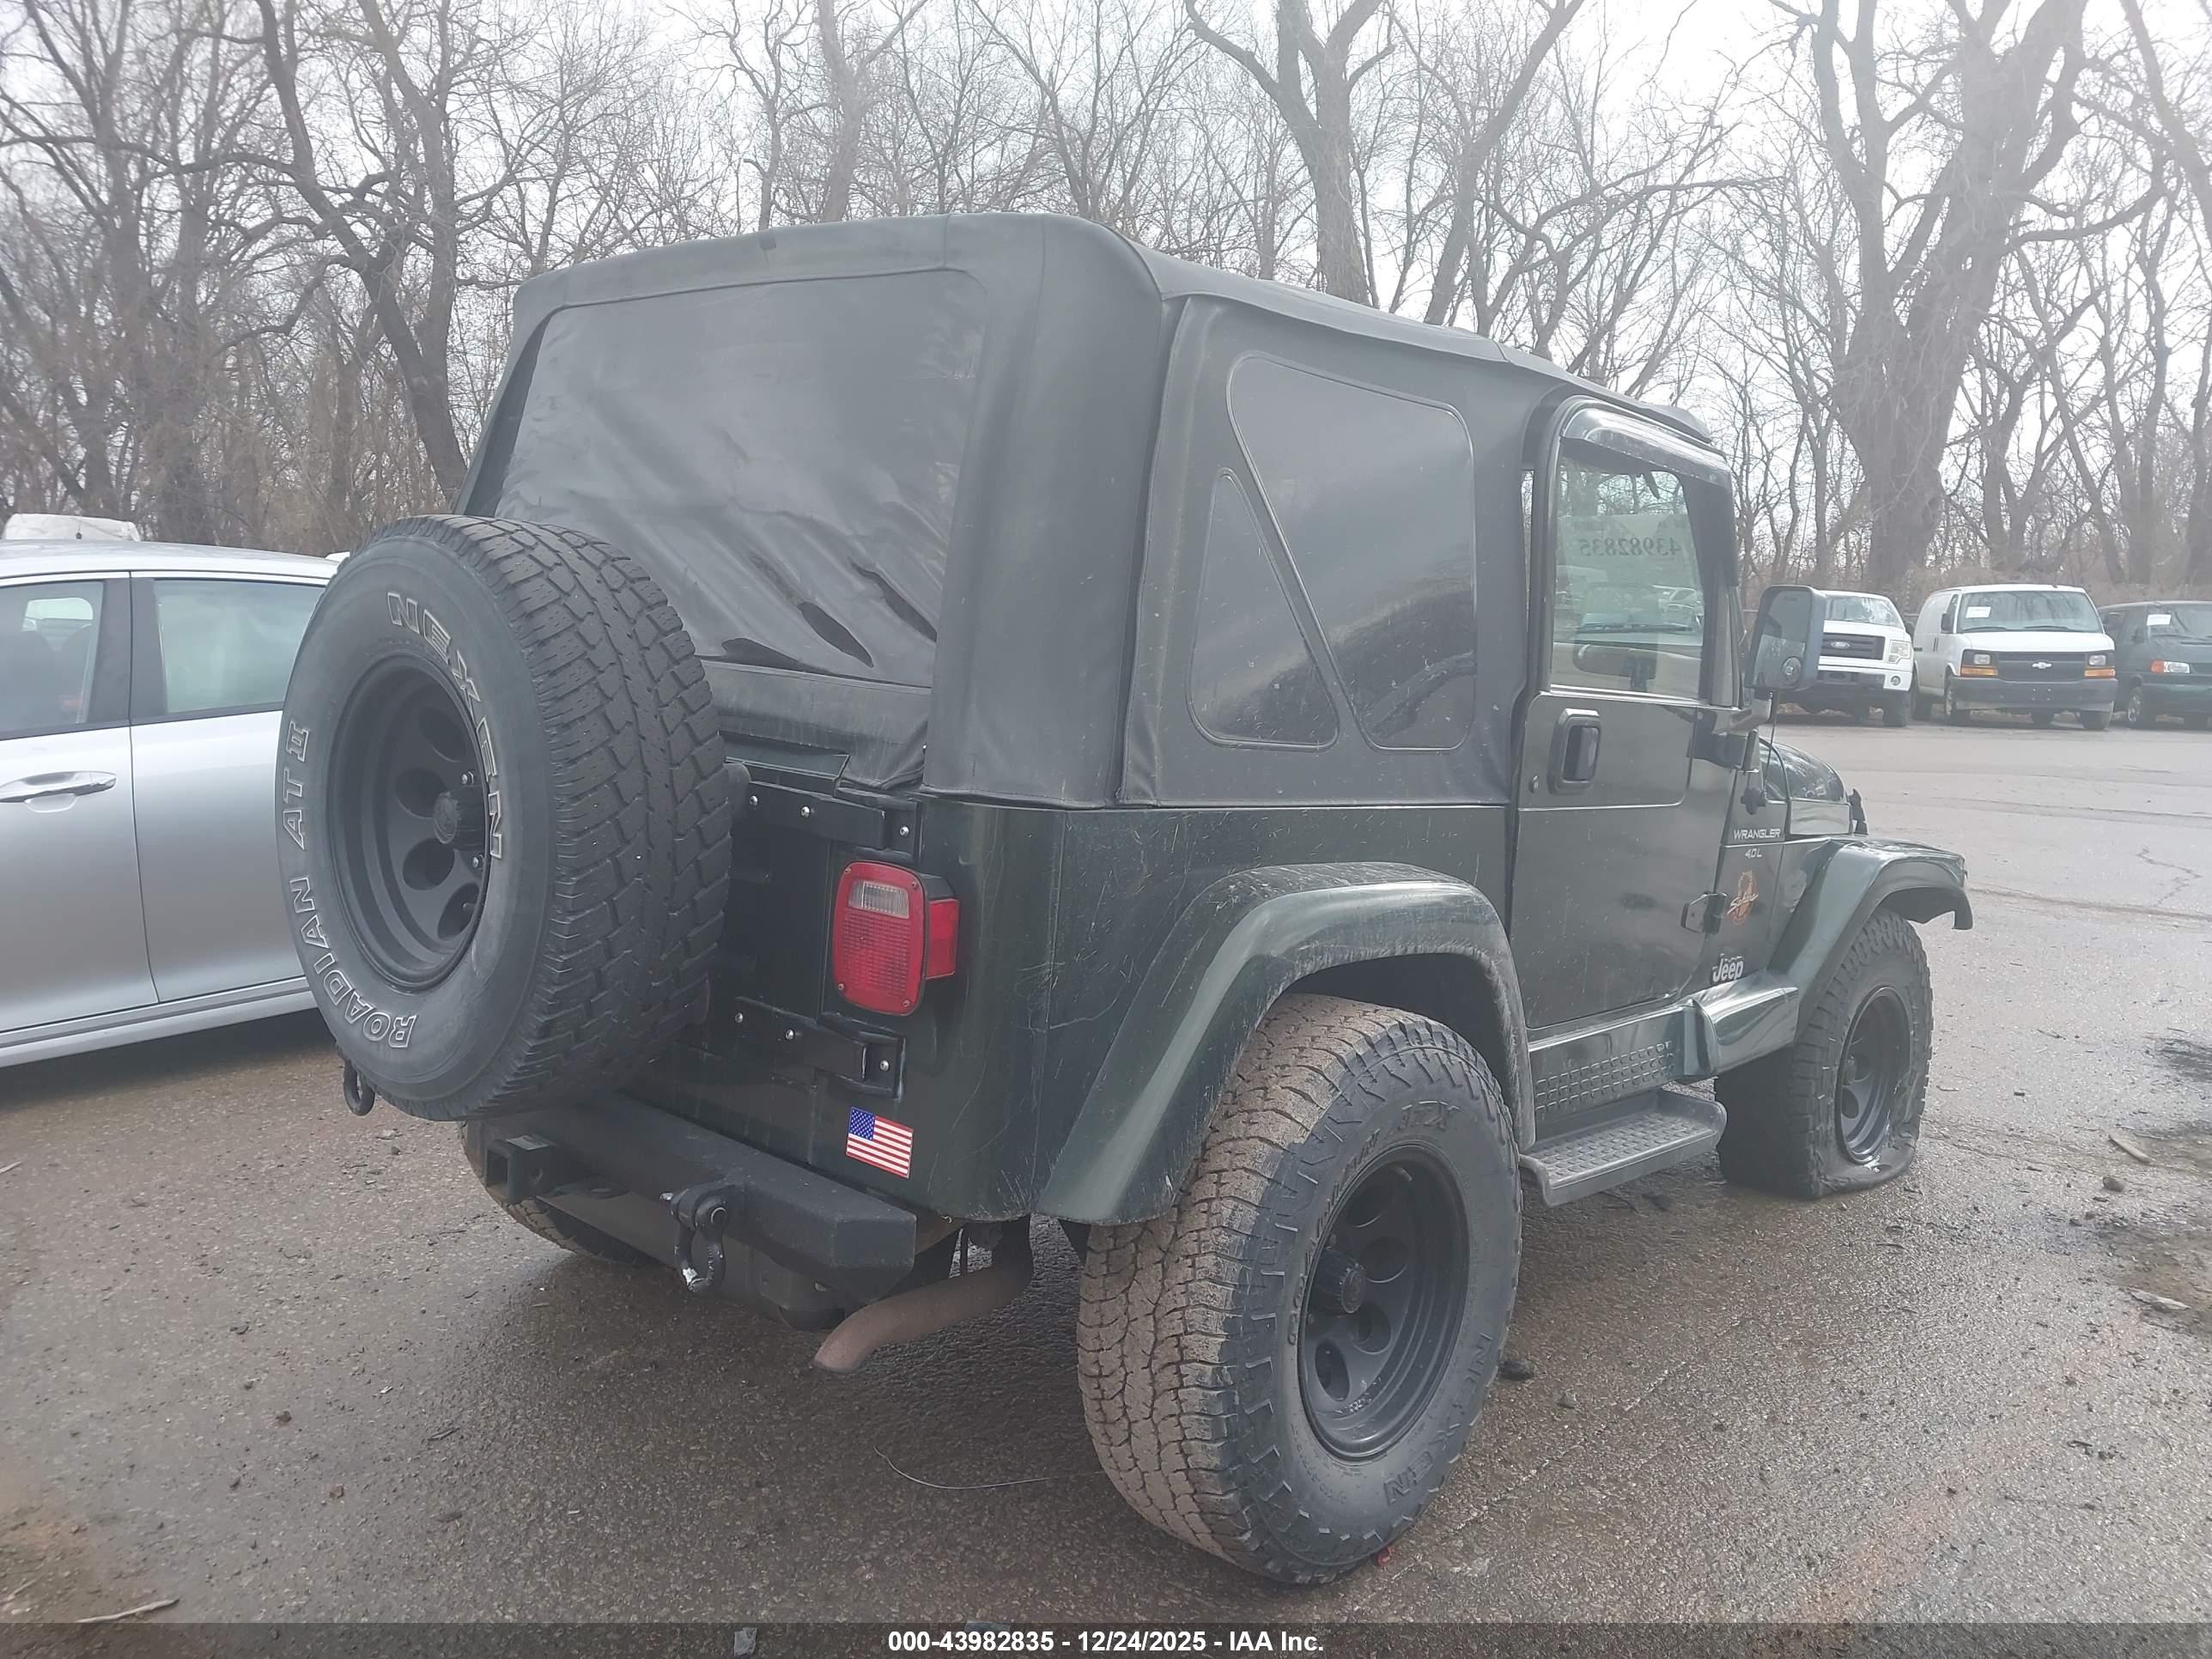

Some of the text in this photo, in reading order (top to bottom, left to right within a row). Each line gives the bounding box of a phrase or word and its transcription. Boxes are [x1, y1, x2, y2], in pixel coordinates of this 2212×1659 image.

[386, 592, 502, 859] NEXEN
[283, 769, 304, 850] AT
[1734, 828, 1781, 839] WRANGLER
[290, 876, 419, 1050] ROADIAN
[1712, 957, 1744, 982] Jeep
